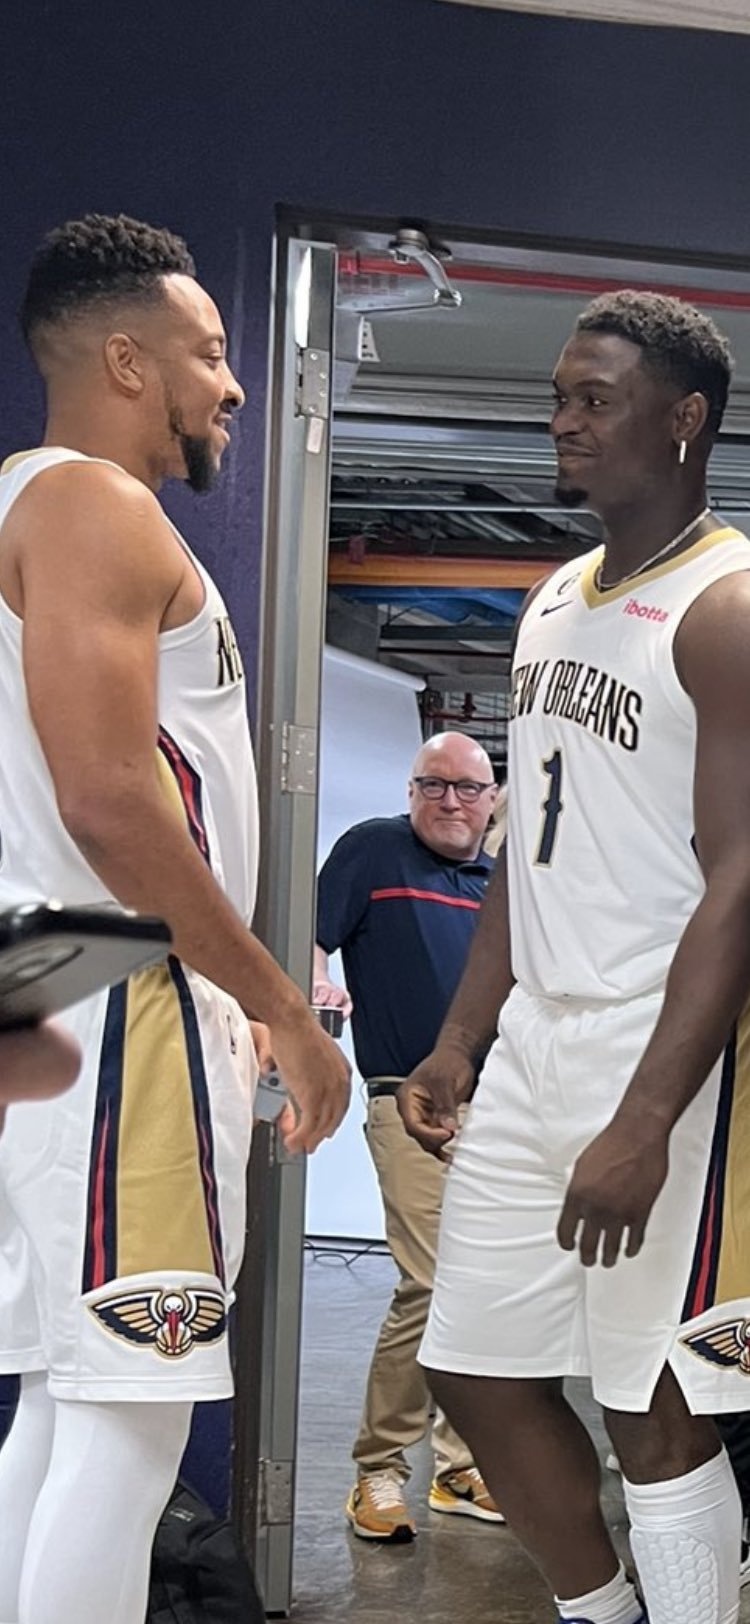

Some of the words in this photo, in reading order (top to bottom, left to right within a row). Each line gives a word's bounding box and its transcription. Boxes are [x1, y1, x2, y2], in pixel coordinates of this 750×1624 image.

[623, 598, 669, 623] ibotta
[510, 659, 549, 720] EW
[542, 658, 643, 753] ORLEANS
[532, 747, 563, 868] 1
